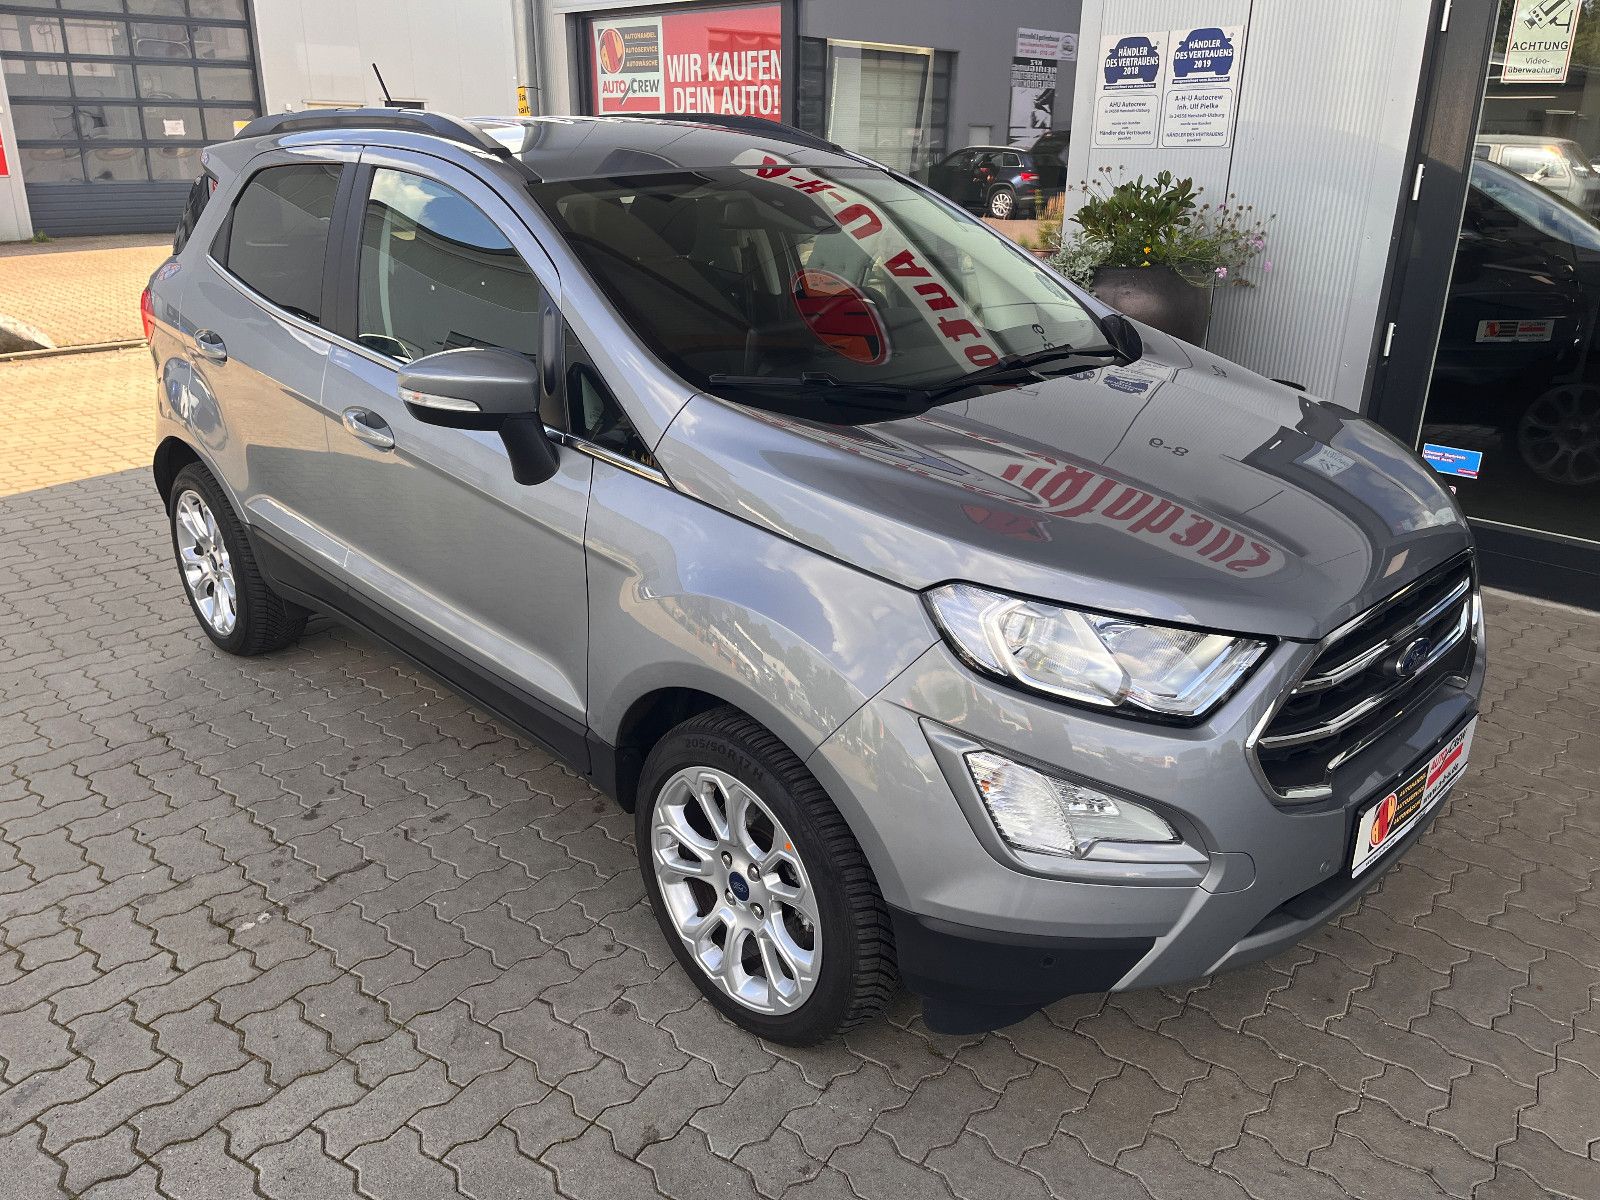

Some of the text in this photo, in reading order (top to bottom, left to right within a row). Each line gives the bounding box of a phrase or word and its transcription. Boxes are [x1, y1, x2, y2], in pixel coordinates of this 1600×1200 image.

[1188, 40, 1221, 50] HÄNDLER
[1511, 41, 1569, 50] ACHTUNG
[1118, 46, 1148, 57] HÄNDLER
[1175, 48, 1233, 60] DES VERTRAUENS
[666, 49, 782, 82] WIR KAUFEN
[1106, 56, 1159, 68] DES VERTRAUENS
[1194, 60, 1212, 68] 2019
[1123, 66, 1139, 75] 2018
[1508, 66, 1563, 74] überwachung!
[602, 78, 660, 94] AUTO CREW
[673, 84, 780, 115] DEIN AUTO!
